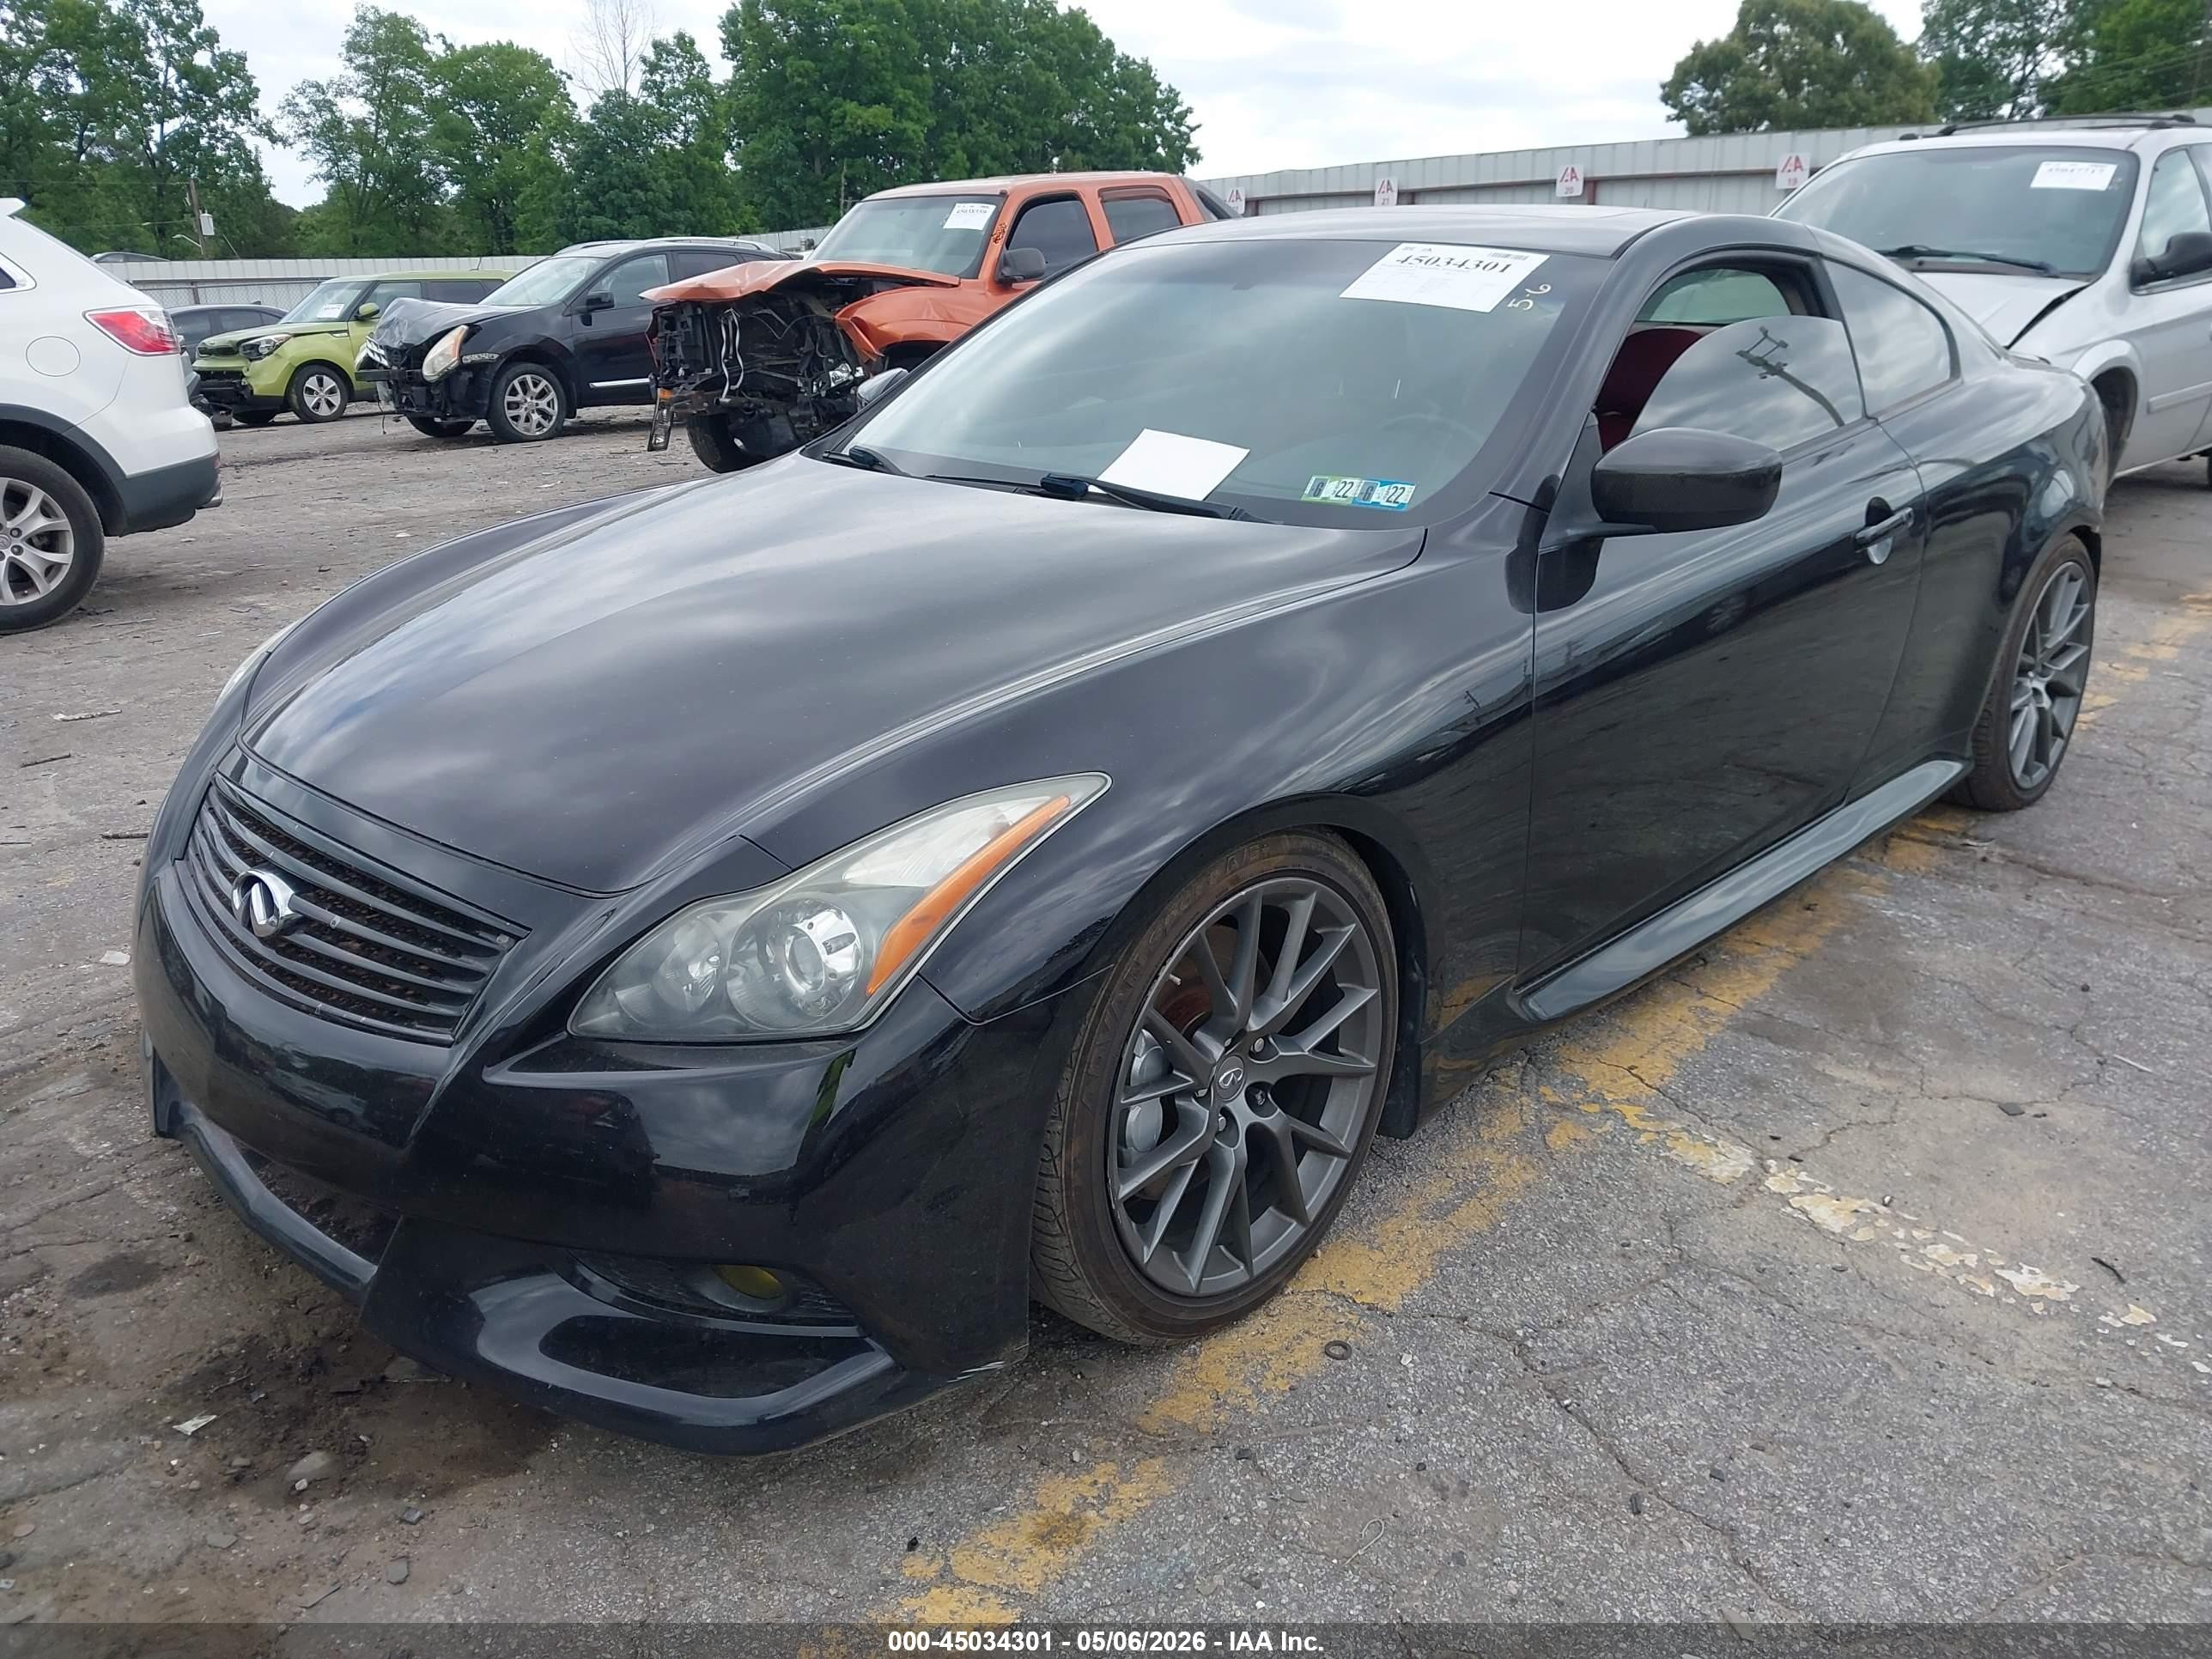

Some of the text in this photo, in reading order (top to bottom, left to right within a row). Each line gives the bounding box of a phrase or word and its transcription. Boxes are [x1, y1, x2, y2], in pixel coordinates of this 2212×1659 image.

[1395, 254, 1512, 273] 45034301
[1335, 481, 1354, 498] 22
[1385, 486, 1406, 504] 22
